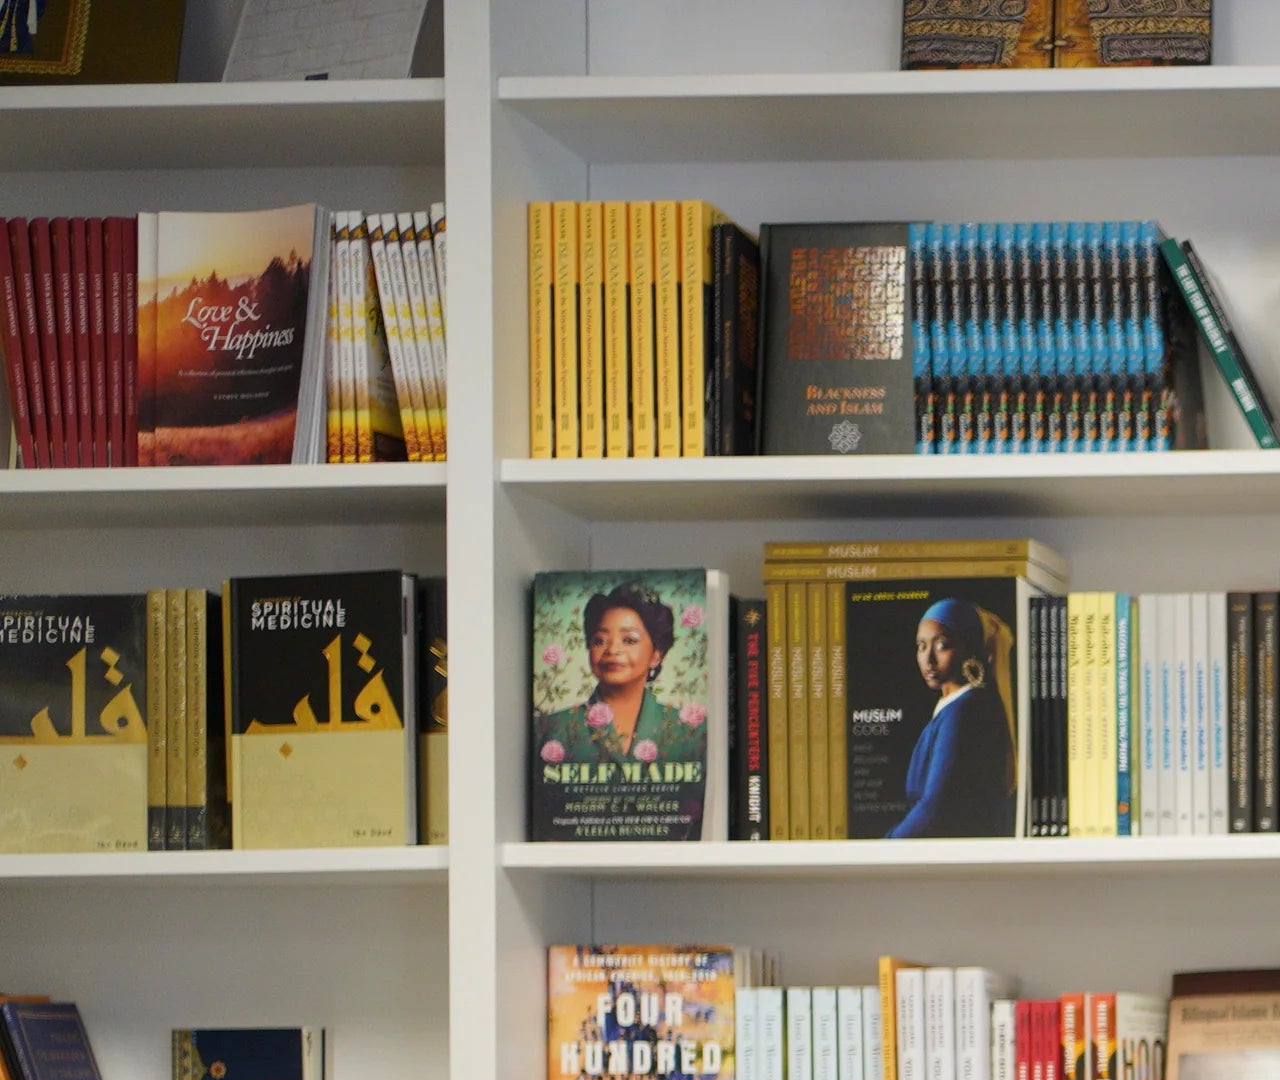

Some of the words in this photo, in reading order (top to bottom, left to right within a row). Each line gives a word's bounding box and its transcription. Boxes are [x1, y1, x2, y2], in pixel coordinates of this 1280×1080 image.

[181, 296, 234, 329] Love
[235, 296, 261, 321] &
[201, 323, 295, 363] Happiness
[828, 545, 880, 557] MUSLIM
[250, 600, 346, 618] SPIRITUAL
[251, 614, 347, 630] MEDICINE
[543, 762, 616, 784] SELF
[621, 761, 701, 783] MADE
[597, 992, 684, 1027] FOUR
[560, 1040, 722, 1075] HUNDRED
